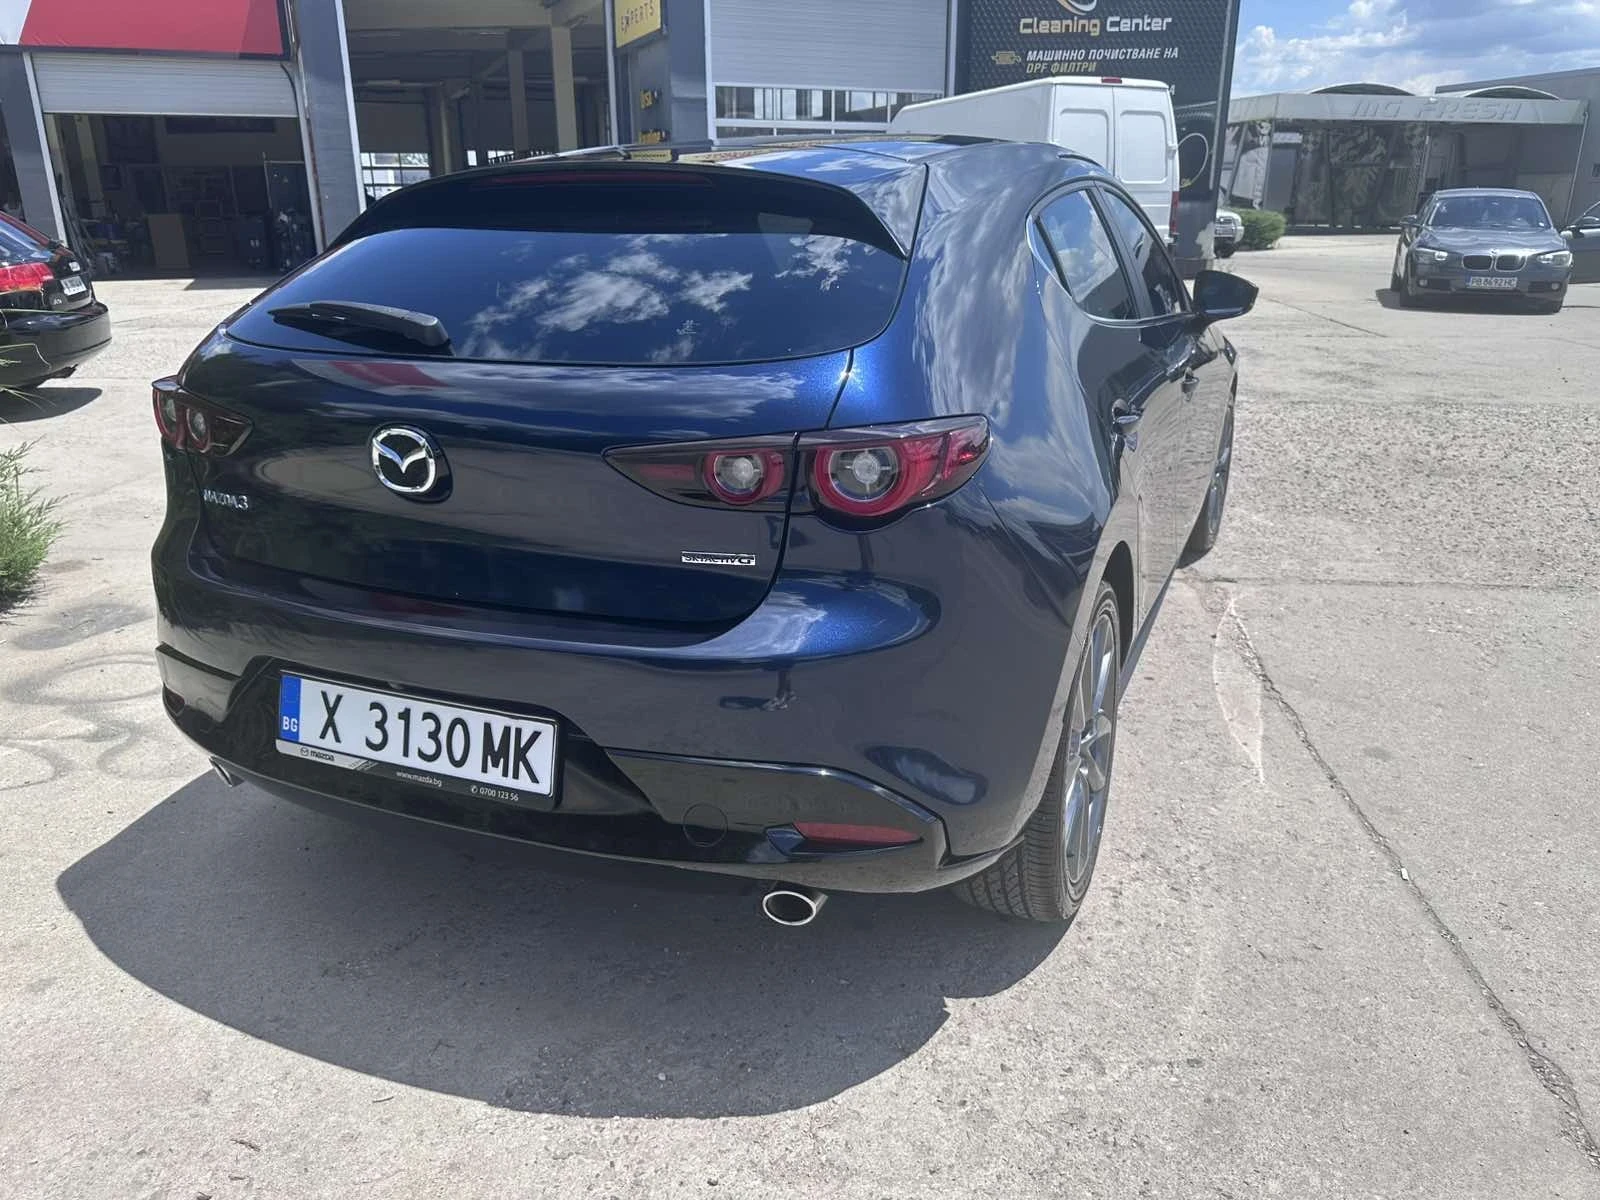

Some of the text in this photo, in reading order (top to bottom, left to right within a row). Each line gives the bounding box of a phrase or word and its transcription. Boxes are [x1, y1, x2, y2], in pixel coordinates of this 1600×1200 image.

[1019, 15, 1172, 36] Cleaning Center
[1026, 47, 1179, 61] МАШИННО ПОЧИСТВАНЕ НА
[1026, 62, 1097, 74] DPF ФИЛТРИ
[282, 717, 298, 732] BG
[319, 690, 542, 784] X 3130 MK
[310, 750, 335, 762] mazda
[396, 771, 442, 787] www.mazda.bg
[479, 787, 519, 801] 0700 123 56
